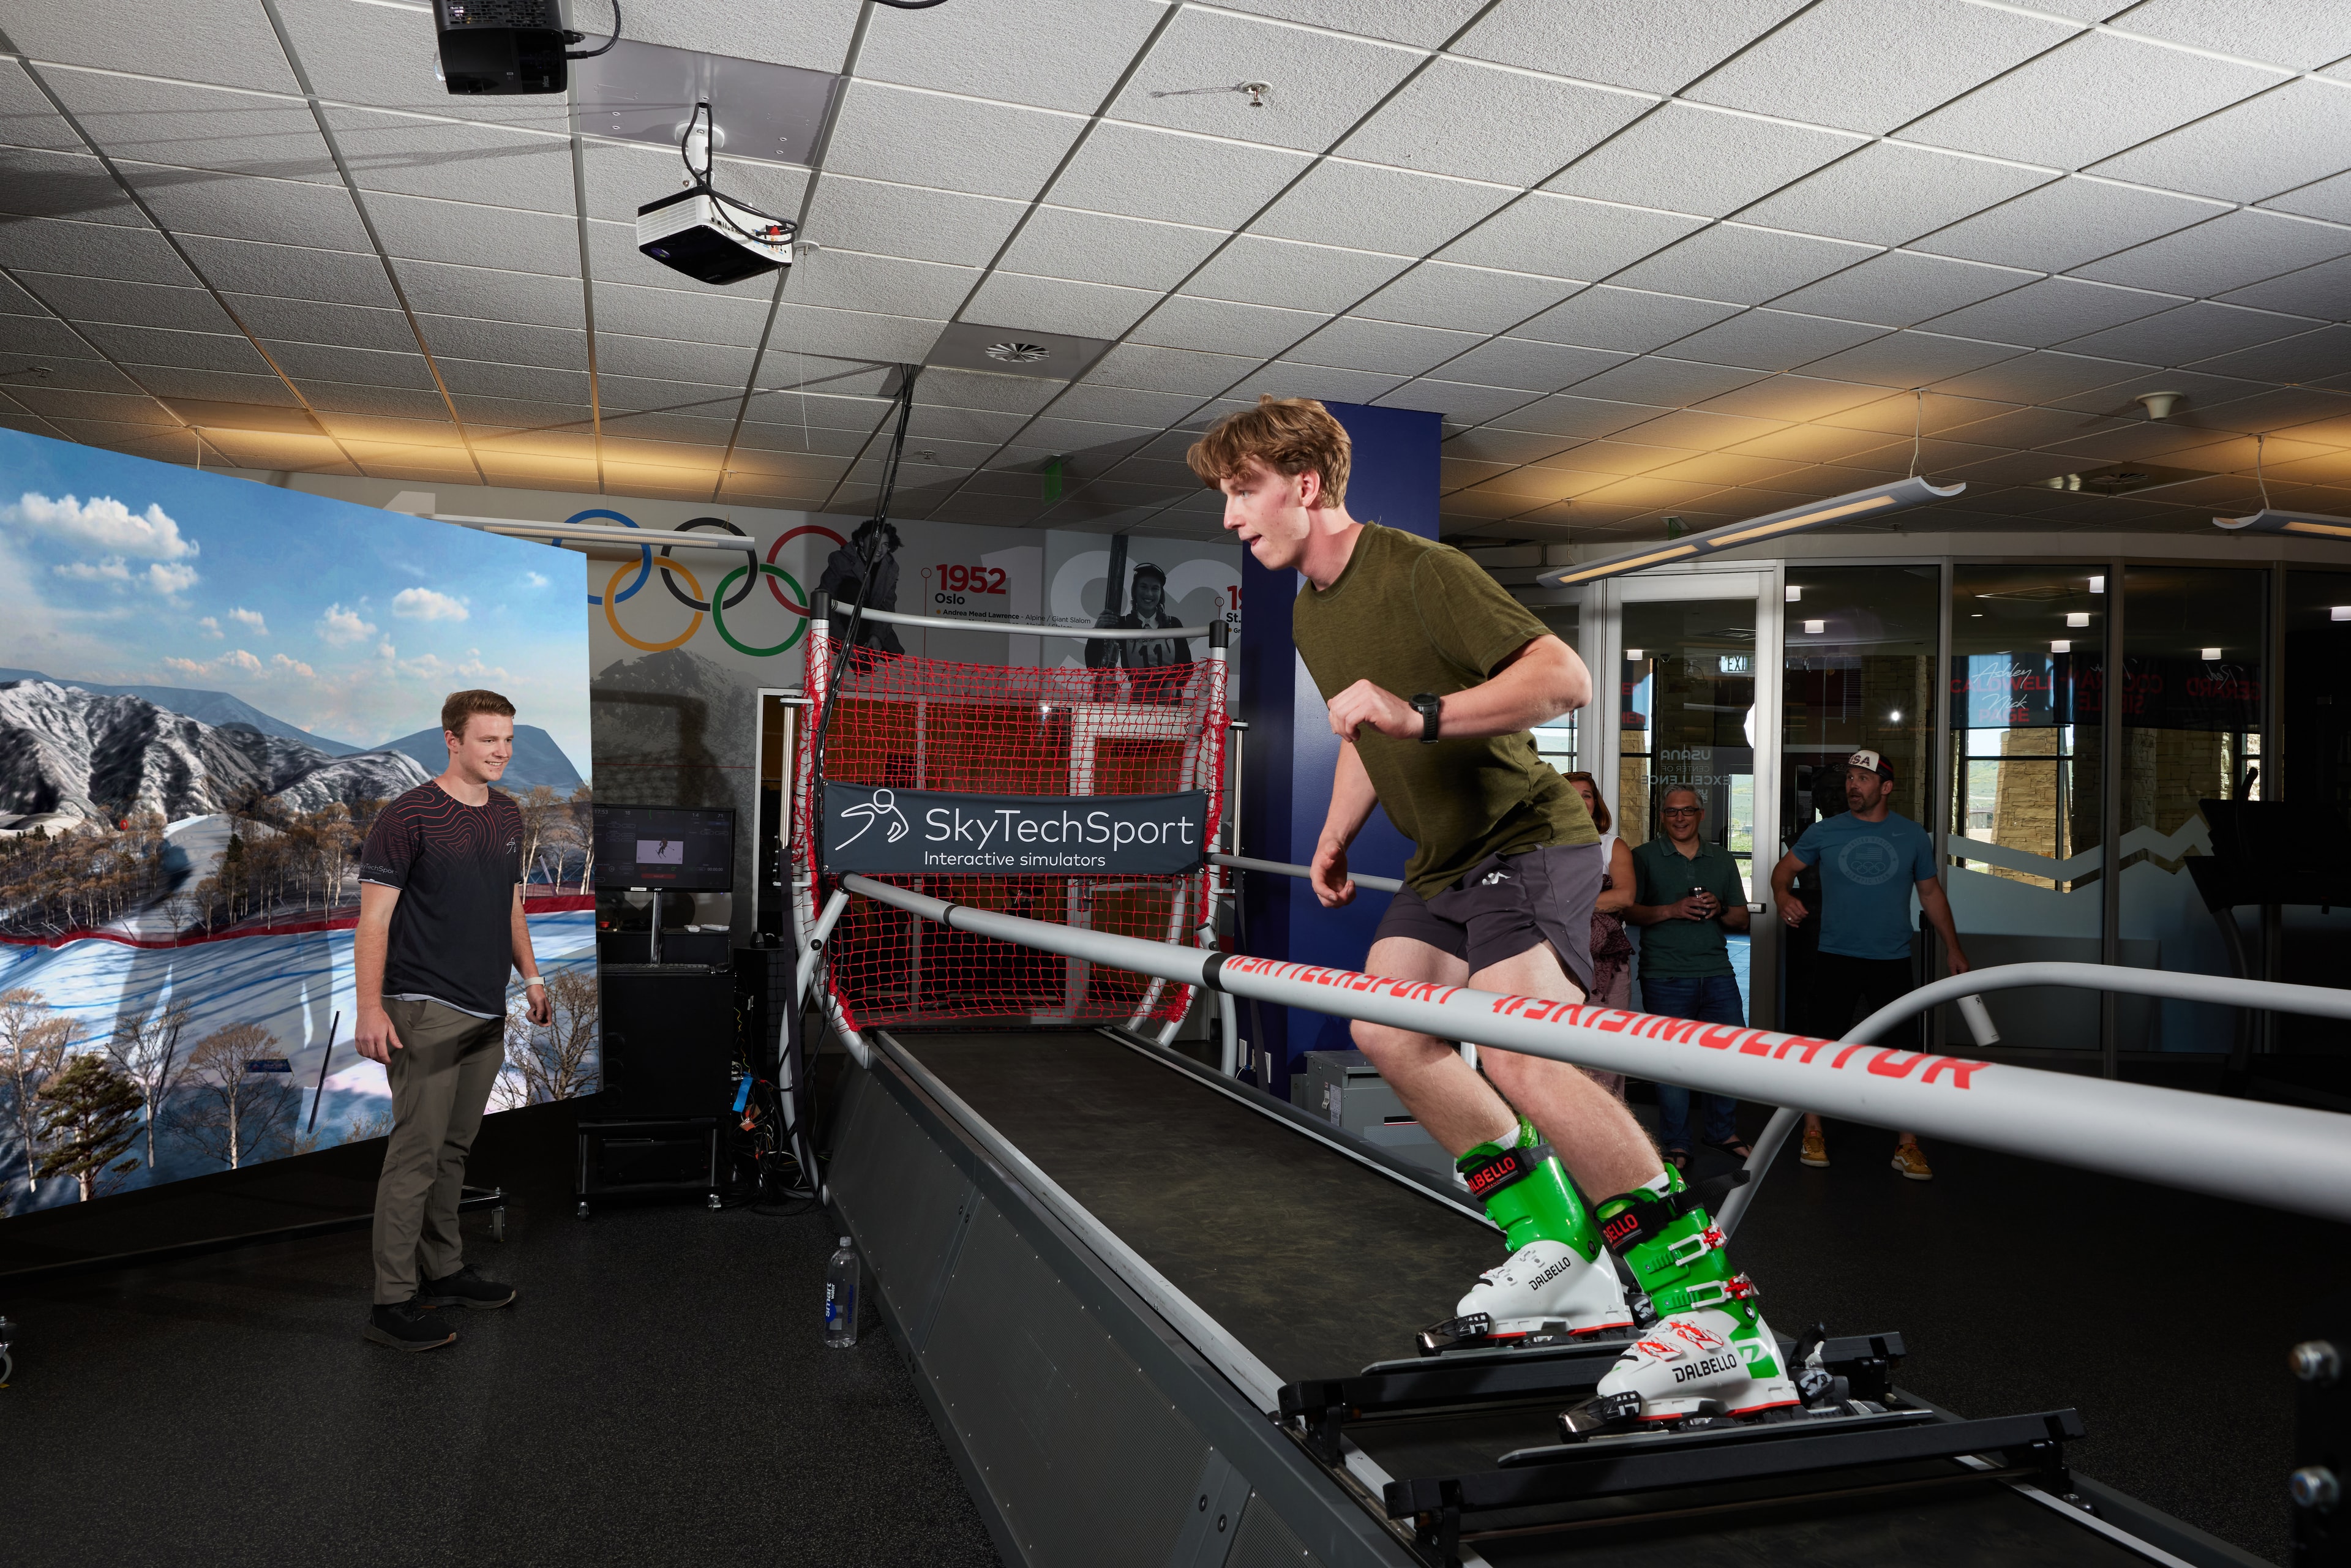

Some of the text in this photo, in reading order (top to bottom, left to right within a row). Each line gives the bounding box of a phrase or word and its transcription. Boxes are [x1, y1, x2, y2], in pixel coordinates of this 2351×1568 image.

[936, 564, 1006, 595] 1952
[935, 593, 965, 605] Oslo
[1227, 585, 1242, 610] 1
[1025, 614, 1046, 623] Alpine
[1226, 612, 1241, 623] St.
[1138, 643, 1163, 672] 11
[1728, 656, 1752, 671] EXIT
[1950, 675, 2054, 694] CALDWELL
[1971, 662, 2032, 689] Ashley
[1978, 707, 2030, 722] PAGE
[1982, 693, 2027, 718] Nick
[925, 808, 1194, 851] SkyTechSport
[924, 850, 1106, 867] Interactive simulators
[1467, 1156, 1517, 1193] ALBELLO
[1602, 1213, 1639, 1245] BELLO
[1528, 1257, 1571, 1291] DALBELLO
[1672, 1354, 1737, 1383] DALBELLO
